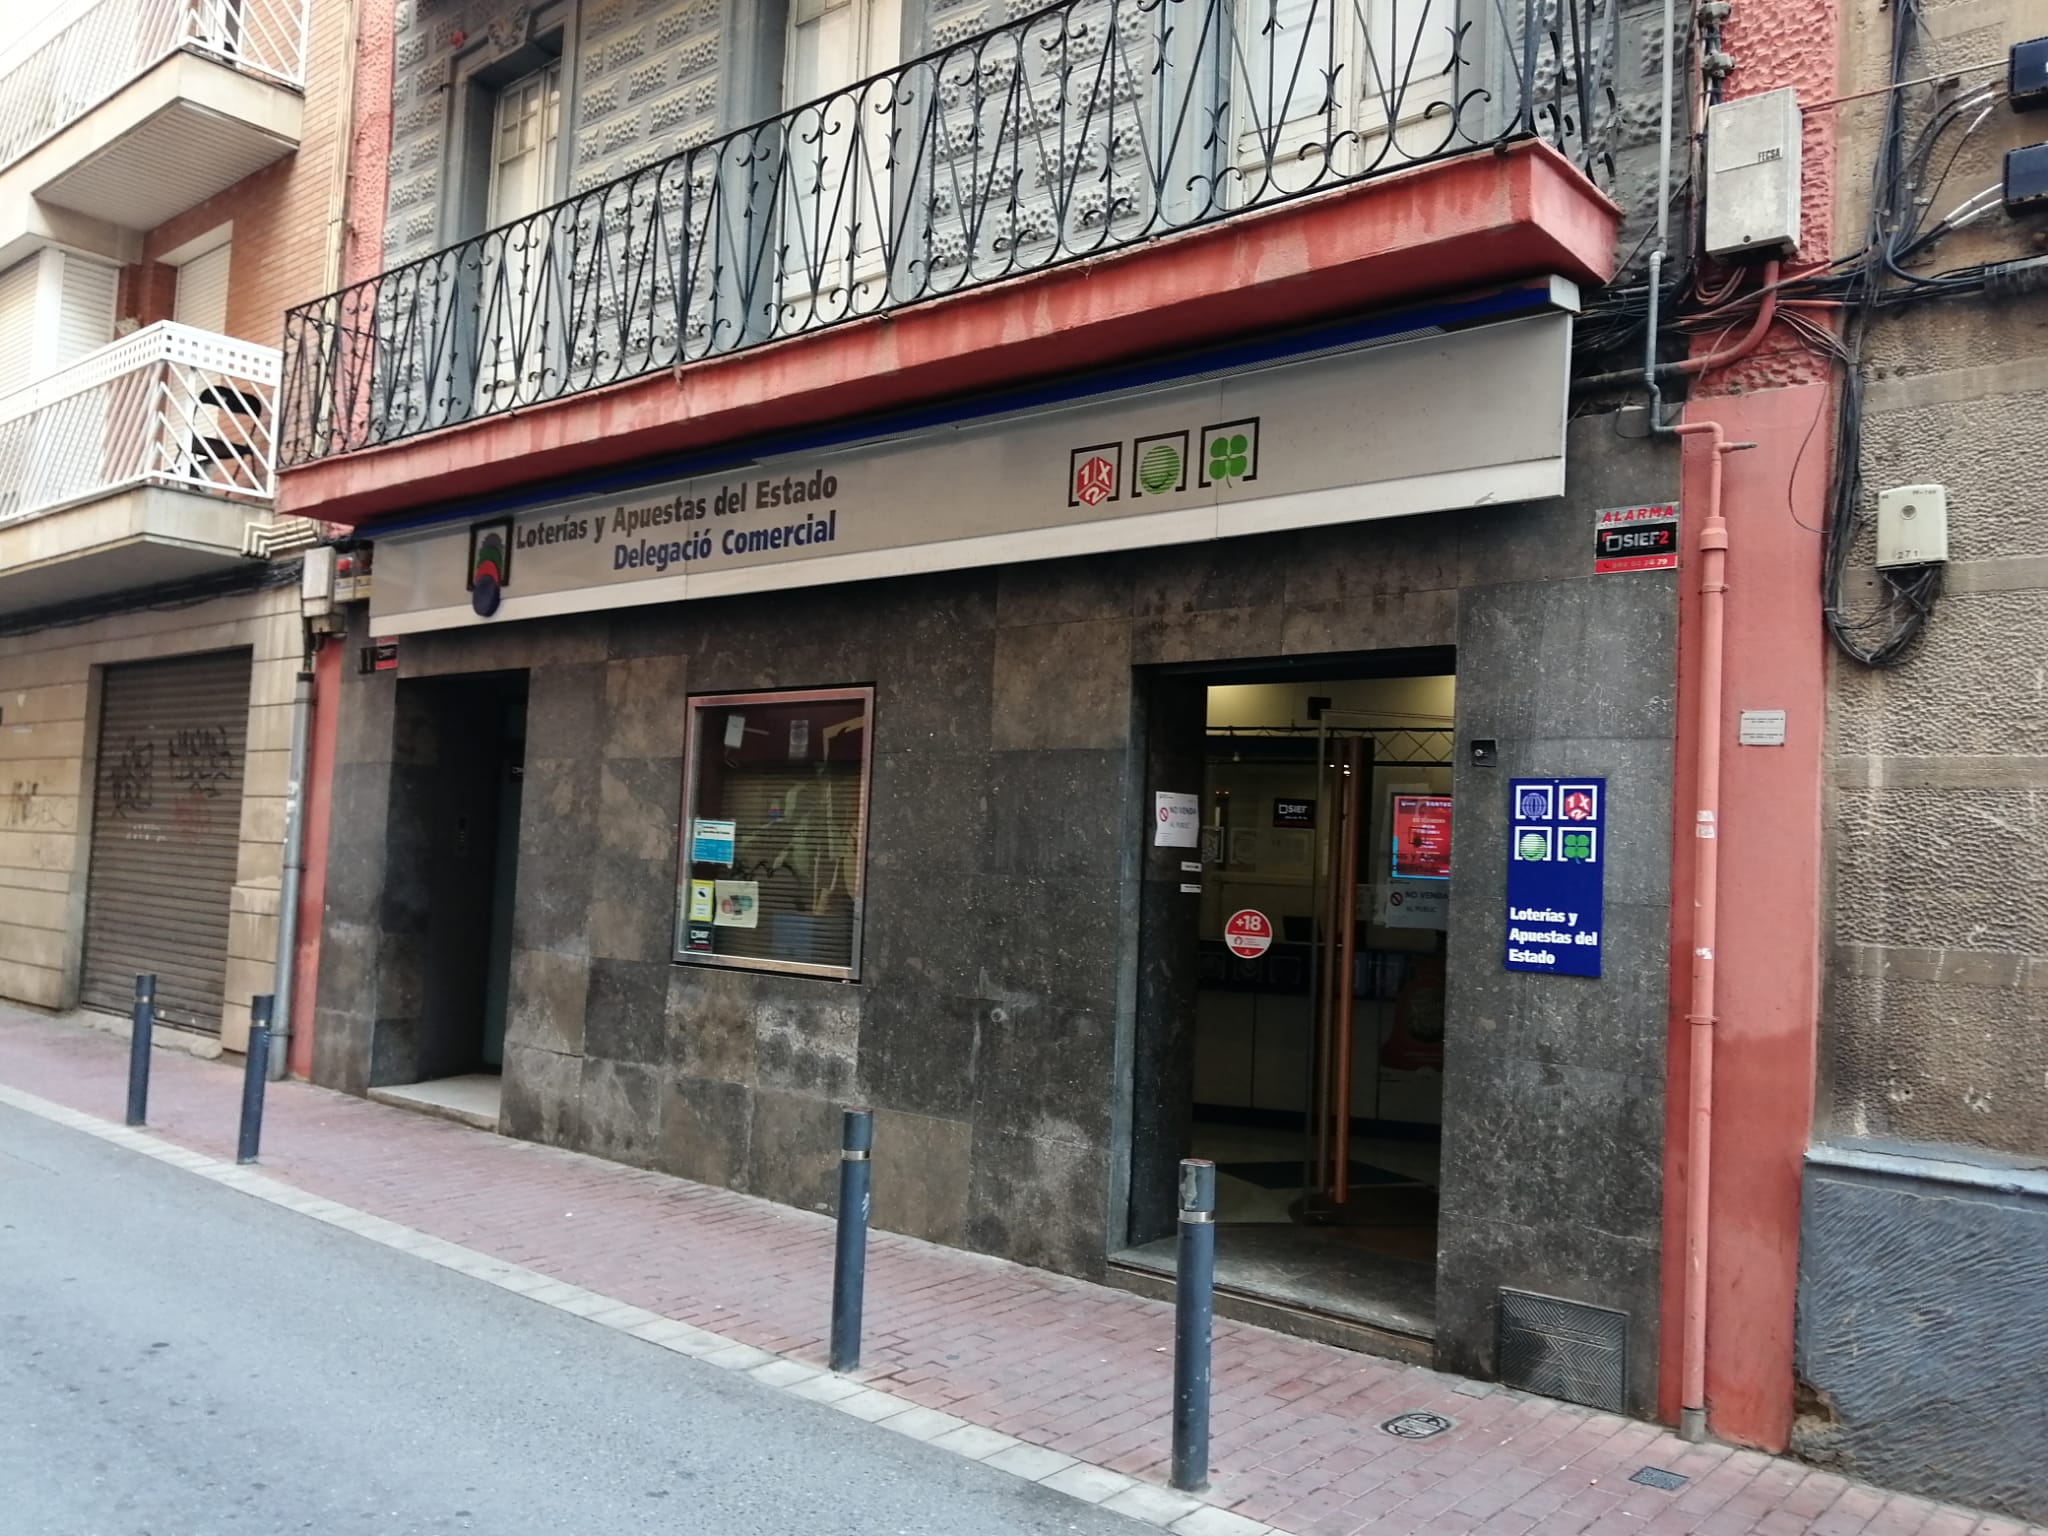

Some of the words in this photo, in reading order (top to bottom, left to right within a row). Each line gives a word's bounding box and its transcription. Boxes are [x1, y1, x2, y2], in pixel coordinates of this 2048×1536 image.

[516, 515, 588, 550] Loterías
[593, 515, 606, 542] y
[612, 496, 706, 534] Apuestas
[714, 485, 747, 517] del
[755, 468, 838, 509] Estado
[1601, 505, 1674, 523] ALARMA
[614, 528, 711, 572] Delegació
[722, 510, 836, 556] Comercial
[1235, 915, 1262, 931] +18
[1510, 907, 1566, 923] Loterías
[1568, 912, 1578, 927] y
[1509, 928, 1573, 944] Apuestas
[1574, 931, 1598, 946] del
[1508, 949, 1556, 965] Estado
